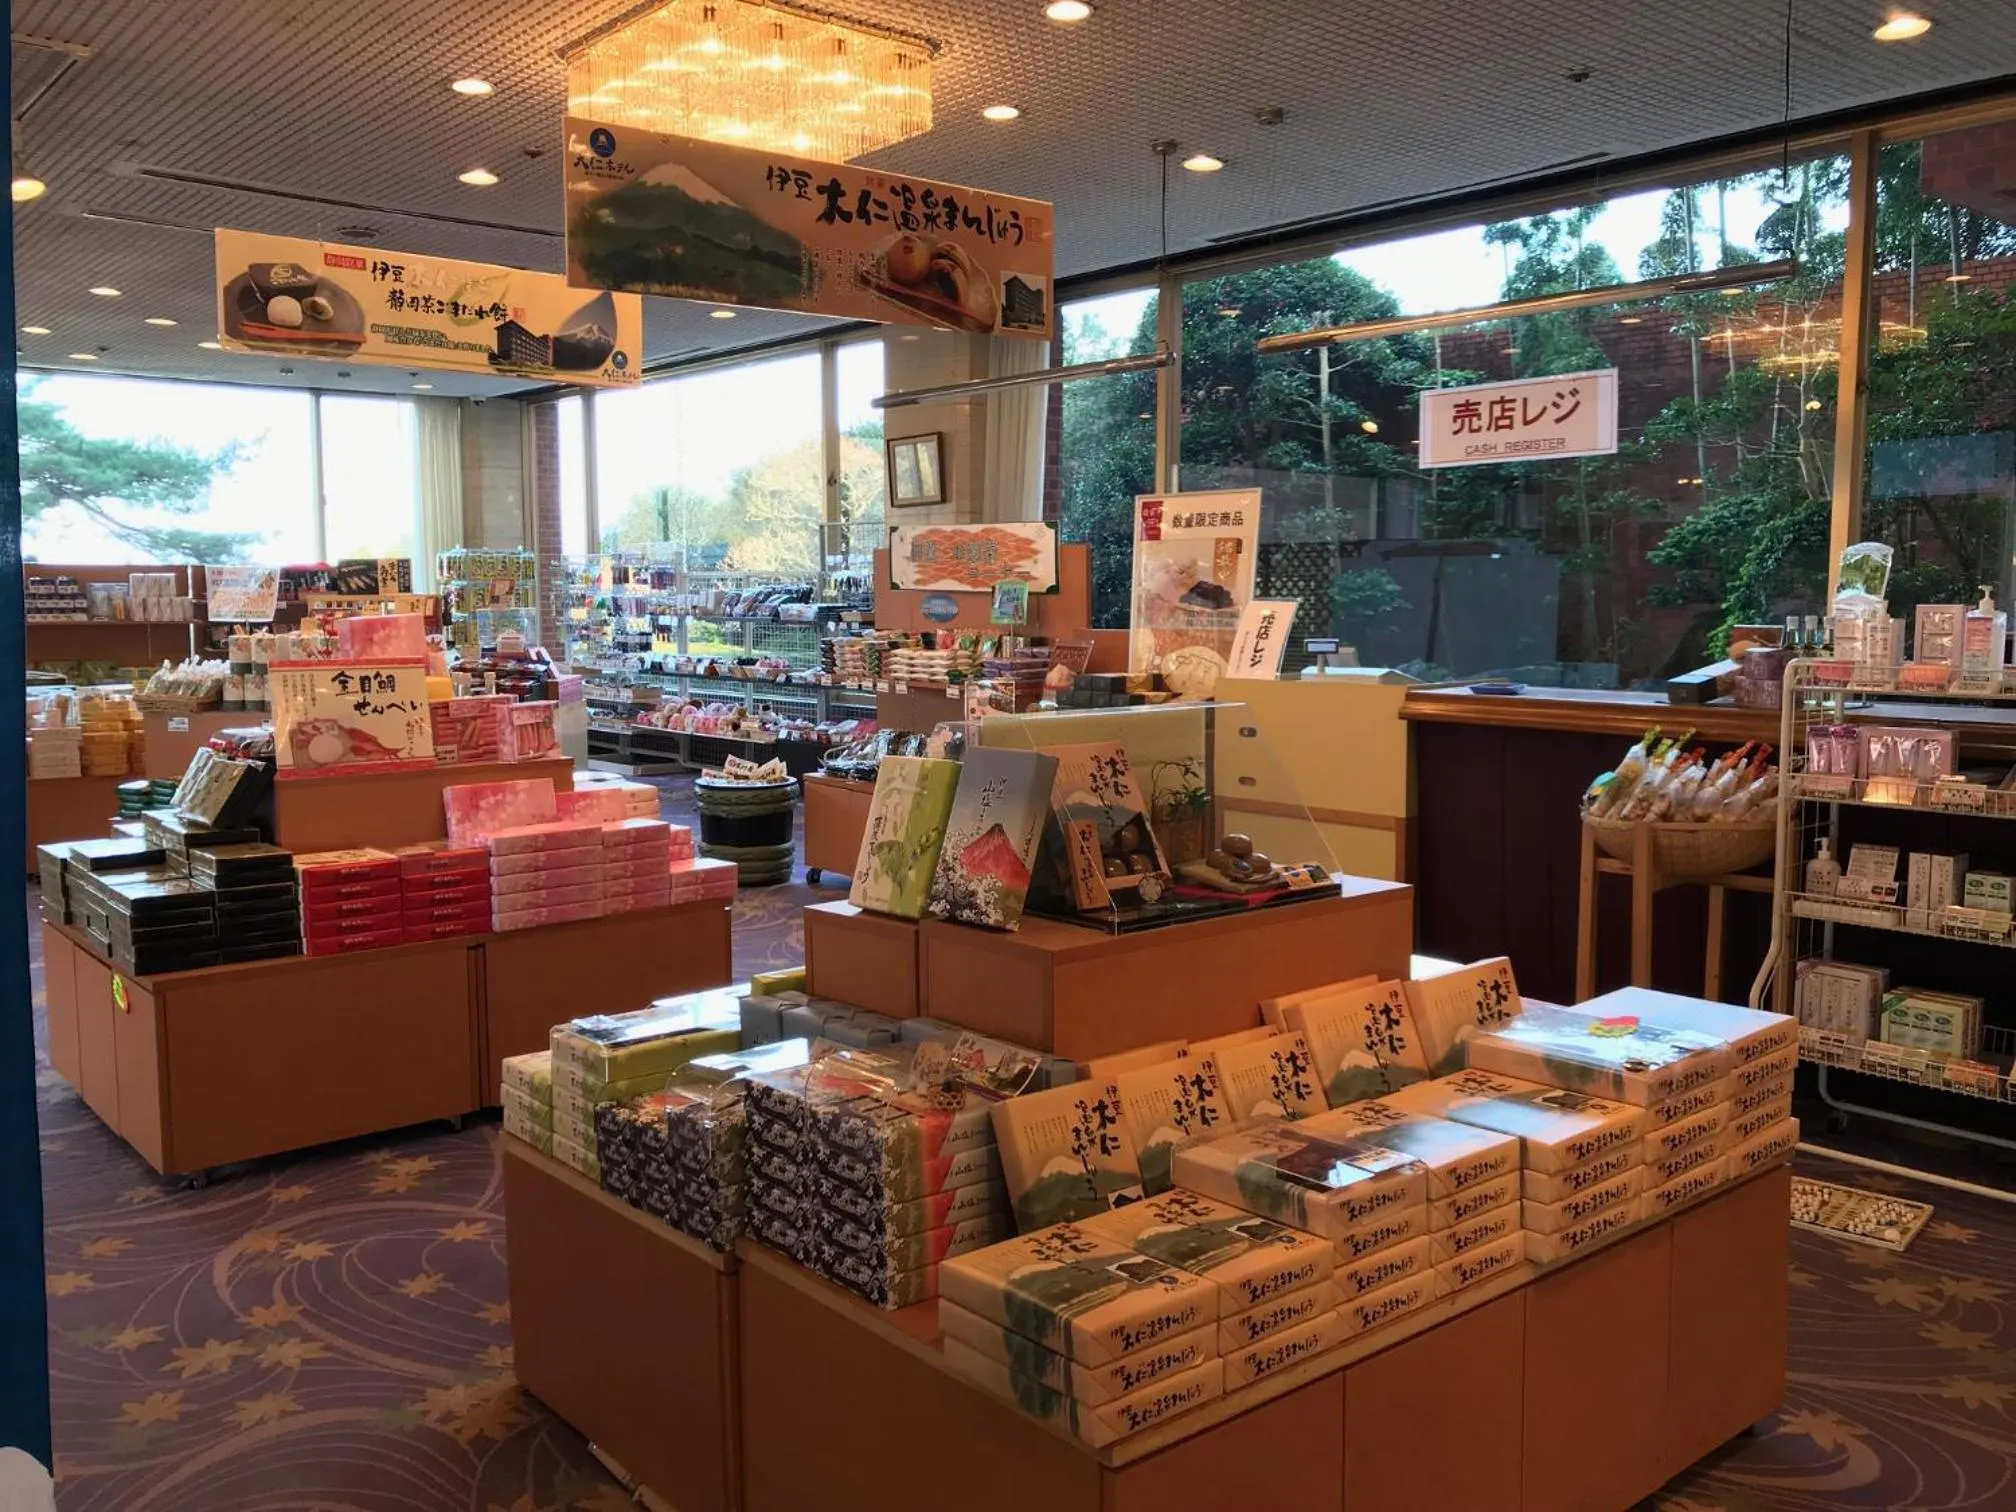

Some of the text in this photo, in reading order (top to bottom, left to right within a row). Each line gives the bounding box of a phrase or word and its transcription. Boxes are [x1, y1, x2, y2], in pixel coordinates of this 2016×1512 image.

[1452, 387, 1581, 436] 売店レジ
[1464, 437, 1567, 456] CASH REGISTER
[1171, 510, 1244, 529] 数量限定商品
[1250, 612, 1275, 668] 売店レジ
[331, 670, 396, 697] 金目鯛
[353, 695, 424, 717] せんべい
